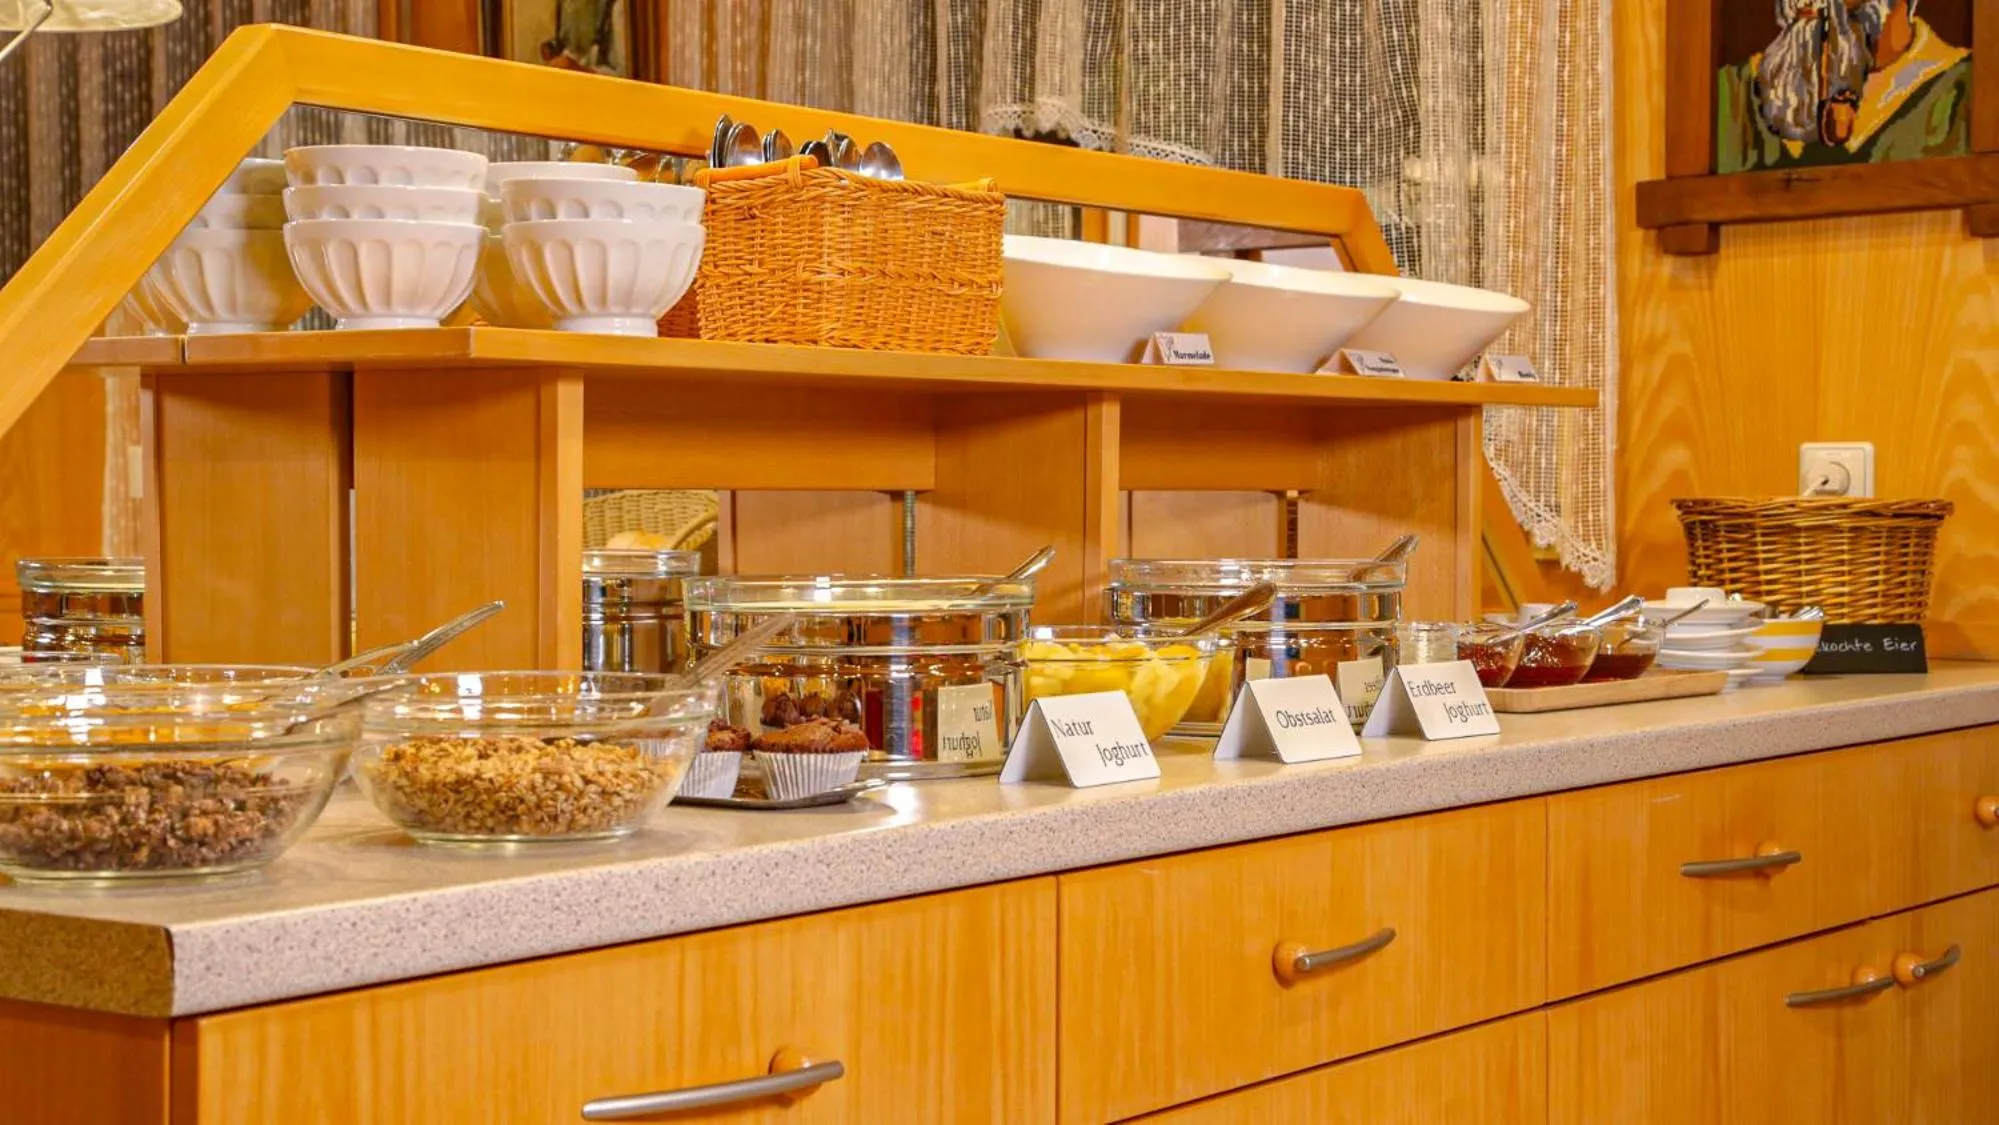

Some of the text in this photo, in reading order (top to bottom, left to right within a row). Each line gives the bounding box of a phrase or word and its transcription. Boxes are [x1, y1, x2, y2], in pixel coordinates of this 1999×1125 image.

[1882, 637, 1918, 652] Eier
[1407, 679, 1457, 698] Erdbeer
[1275, 707, 1337, 729] Obstsalat
[1442, 701, 1490, 724] Joghurt
[1050, 718, 1095, 739] Natur
[1096, 741, 1149, 768] Joghurt
